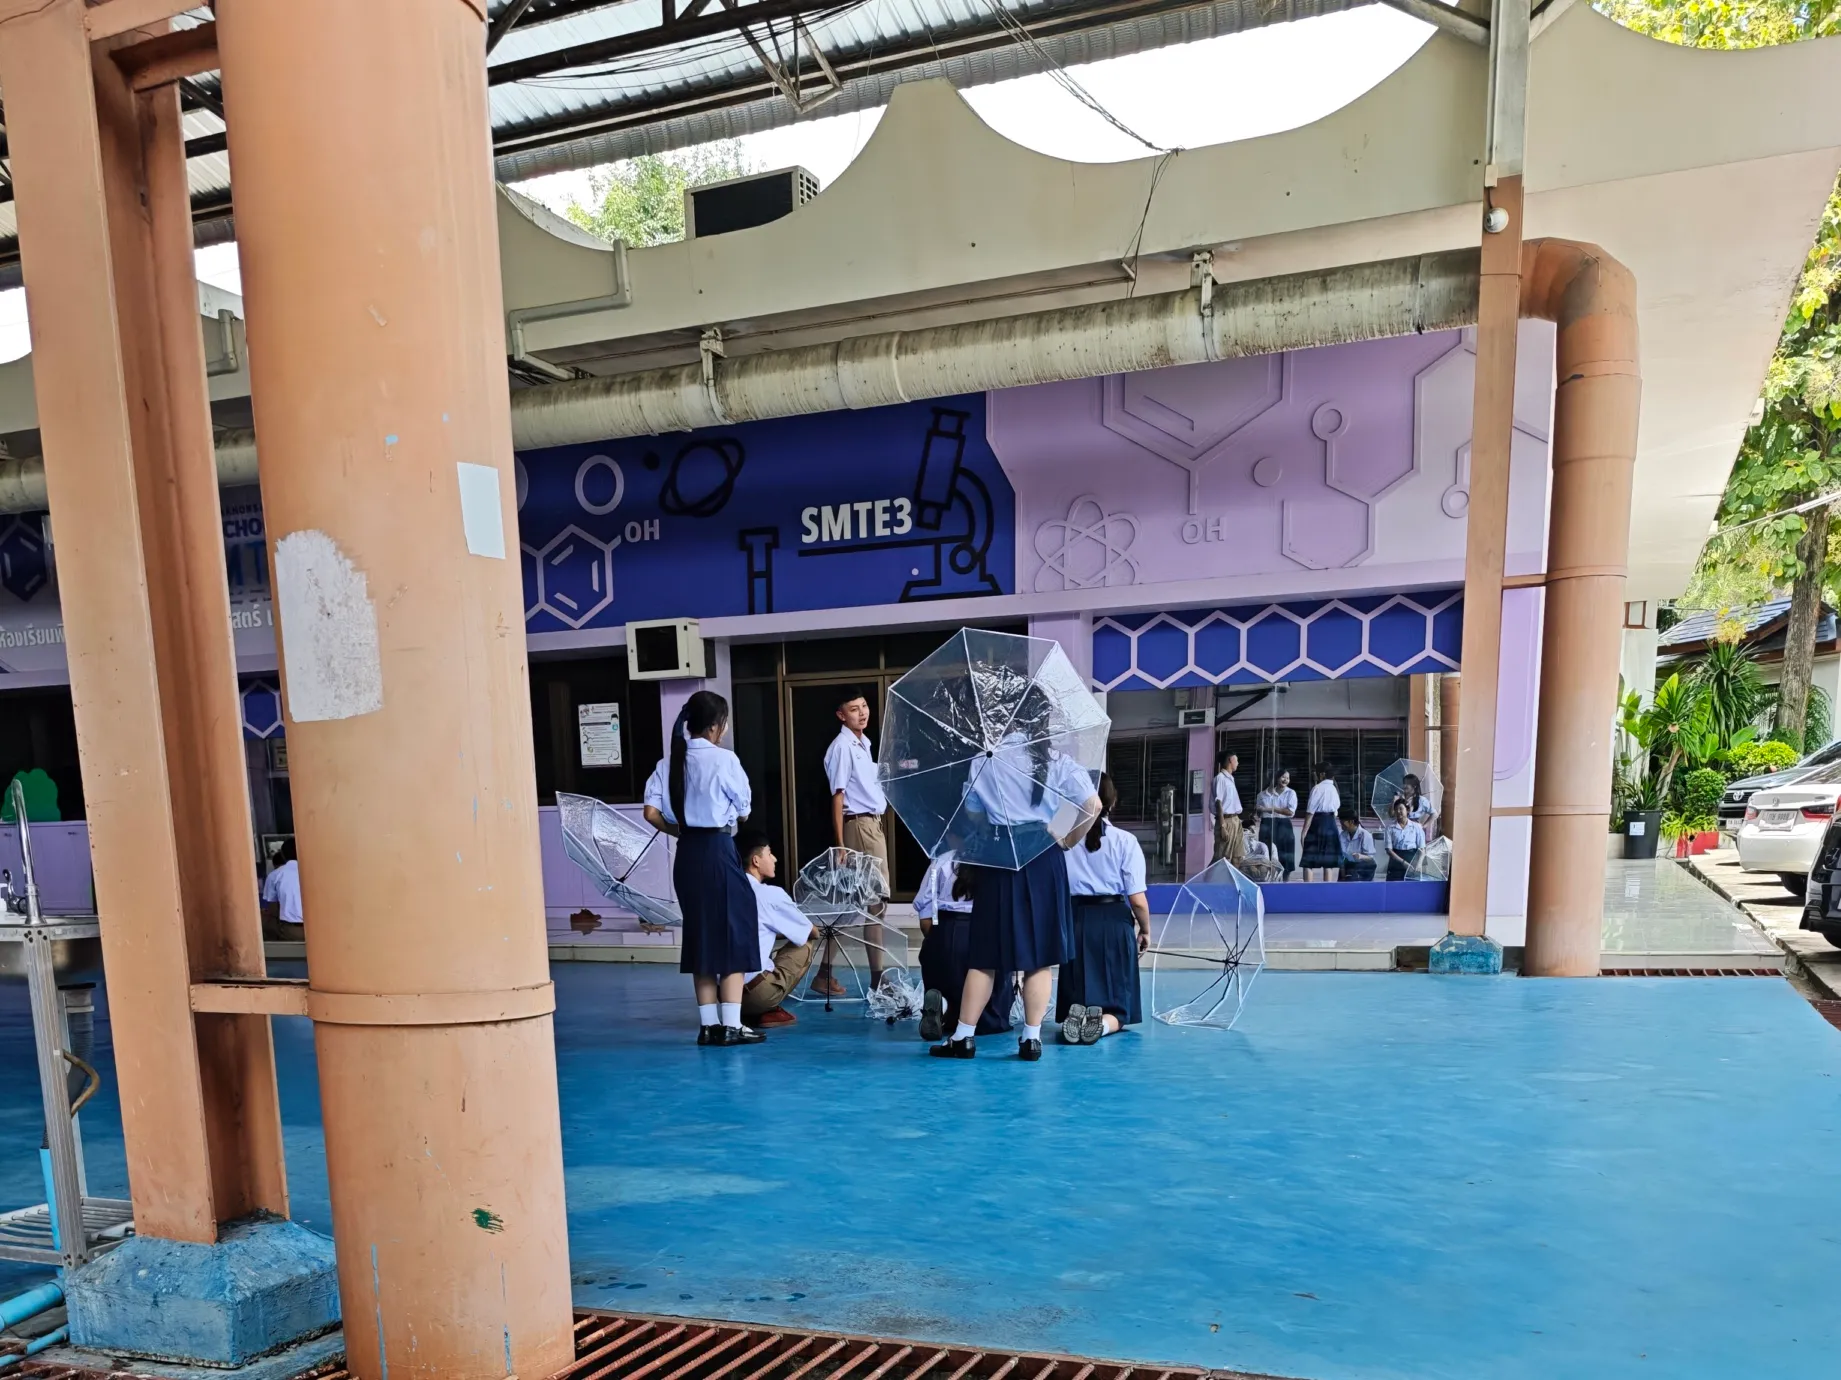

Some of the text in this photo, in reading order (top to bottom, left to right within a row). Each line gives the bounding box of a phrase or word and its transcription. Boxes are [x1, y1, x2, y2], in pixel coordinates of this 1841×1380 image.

[223, 517, 262, 538] CHO
[624, 518, 660, 543] OH
[801, 497, 912, 543] SMTE3
[1182, 516, 1226, 544] OH
[232, 603, 262, 628] สตร์
